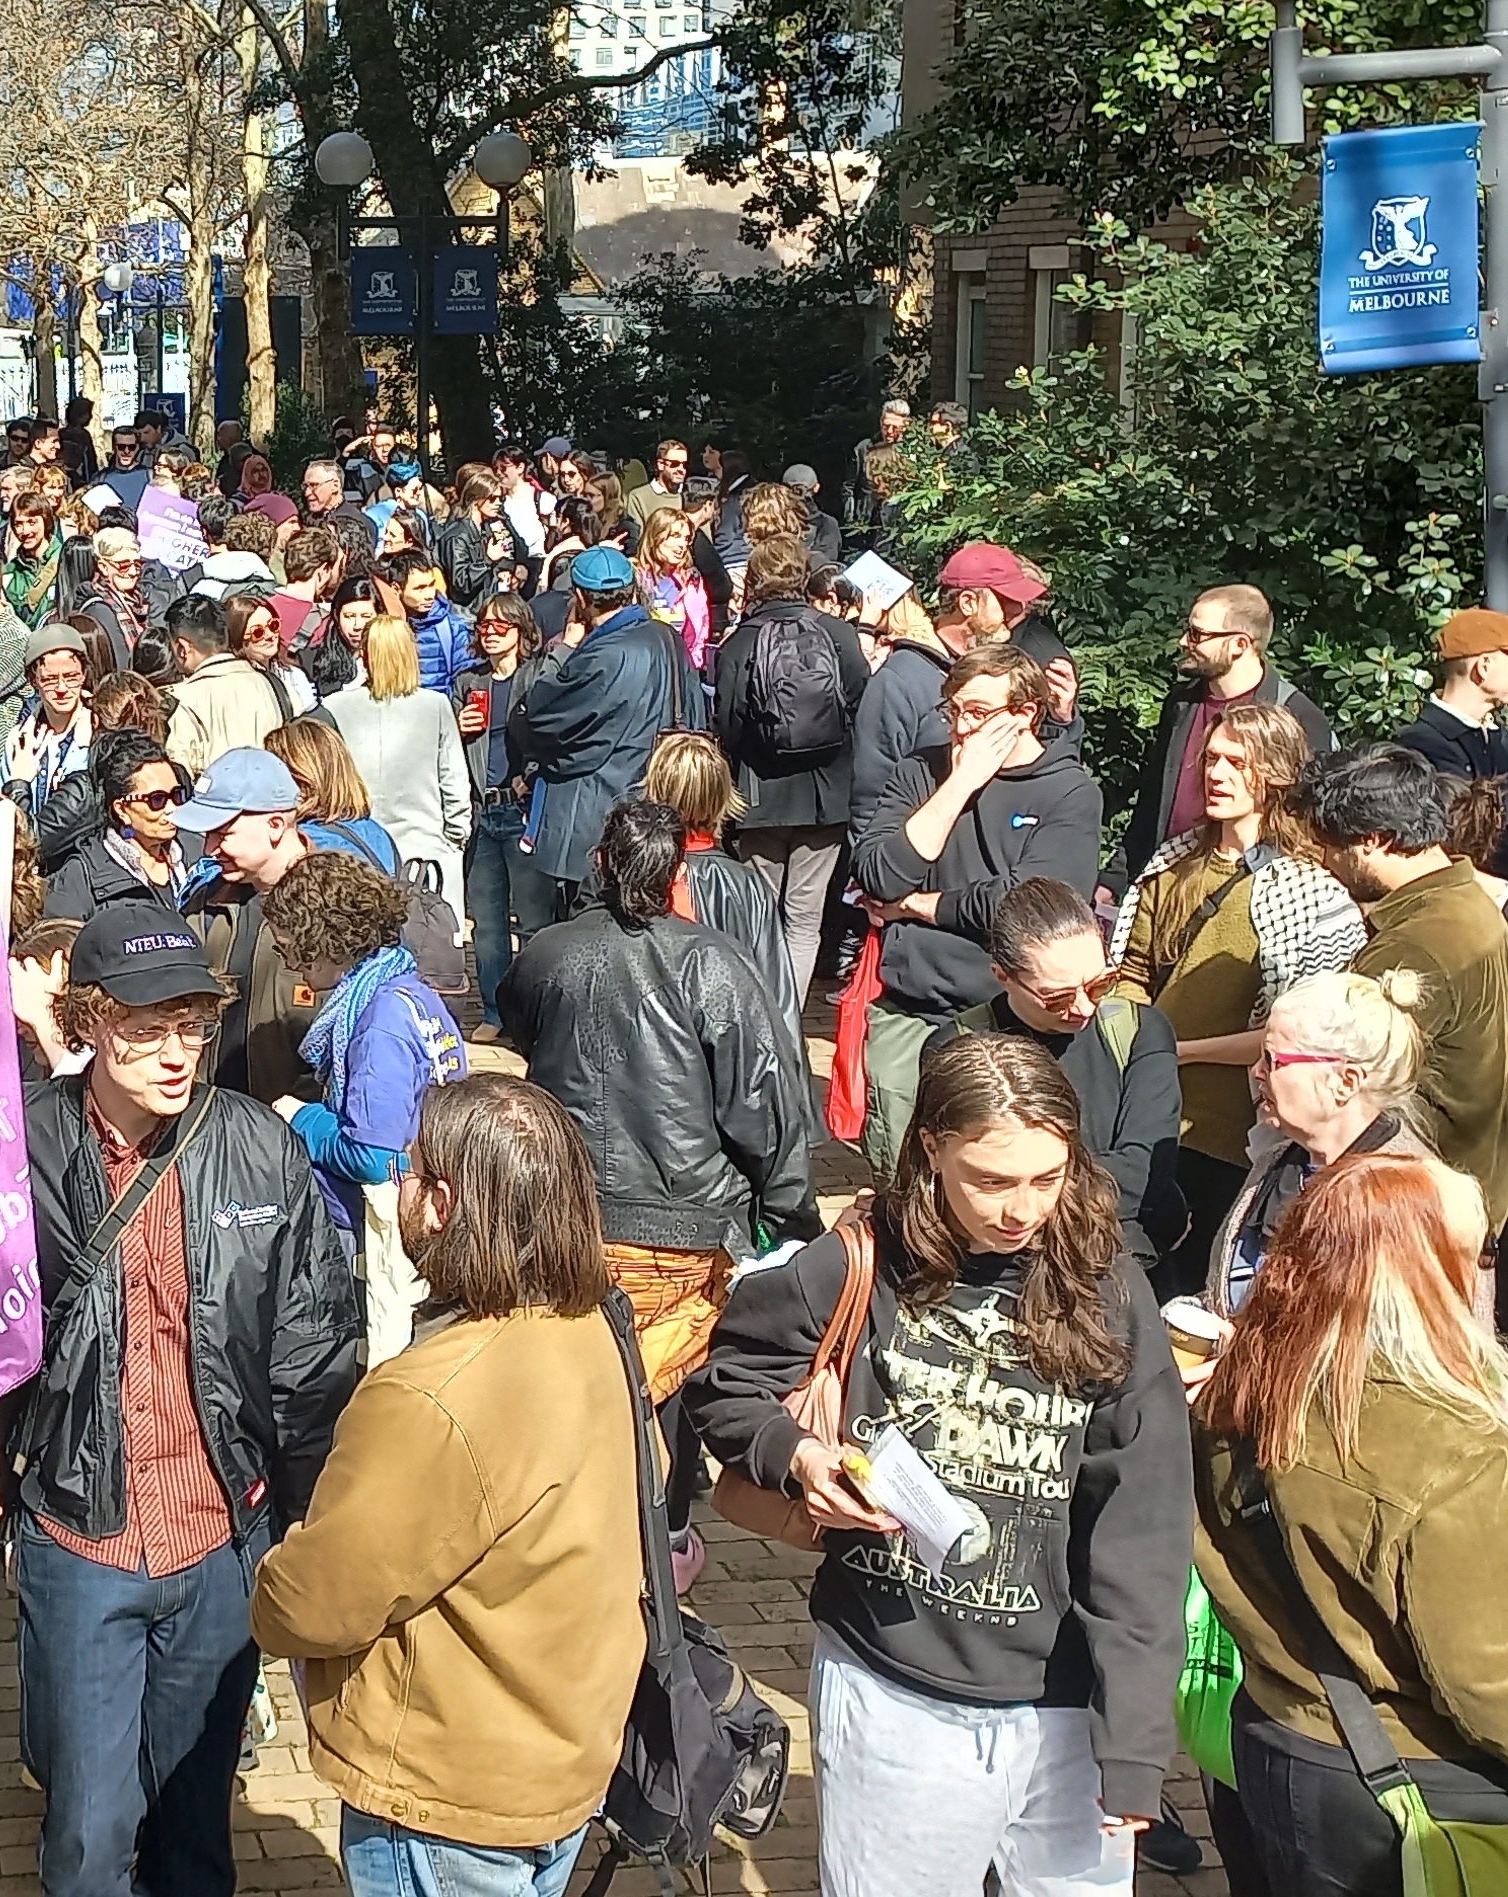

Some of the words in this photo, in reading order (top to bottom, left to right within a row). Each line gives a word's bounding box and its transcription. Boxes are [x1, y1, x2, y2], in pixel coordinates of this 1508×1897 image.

[1348, 276, 1370, 288] THE
[1372, 270, 1433, 286] UNIVERSITY
[1435, 268, 1449, 281] OF
[1349, 289, 1450, 312] MELBOURNE
[966, 1373, 1093, 1427] HOUR
[935, 1408, 1069, 1473] DAWN
[919, 1450, 1026, 1497] Stadium
[1028, 1472, 1071, 1500] Tou
[842, 1544, 1043, 1614] AUSTRALIA
[921, 1595, 1020, 1628] WEEKND
